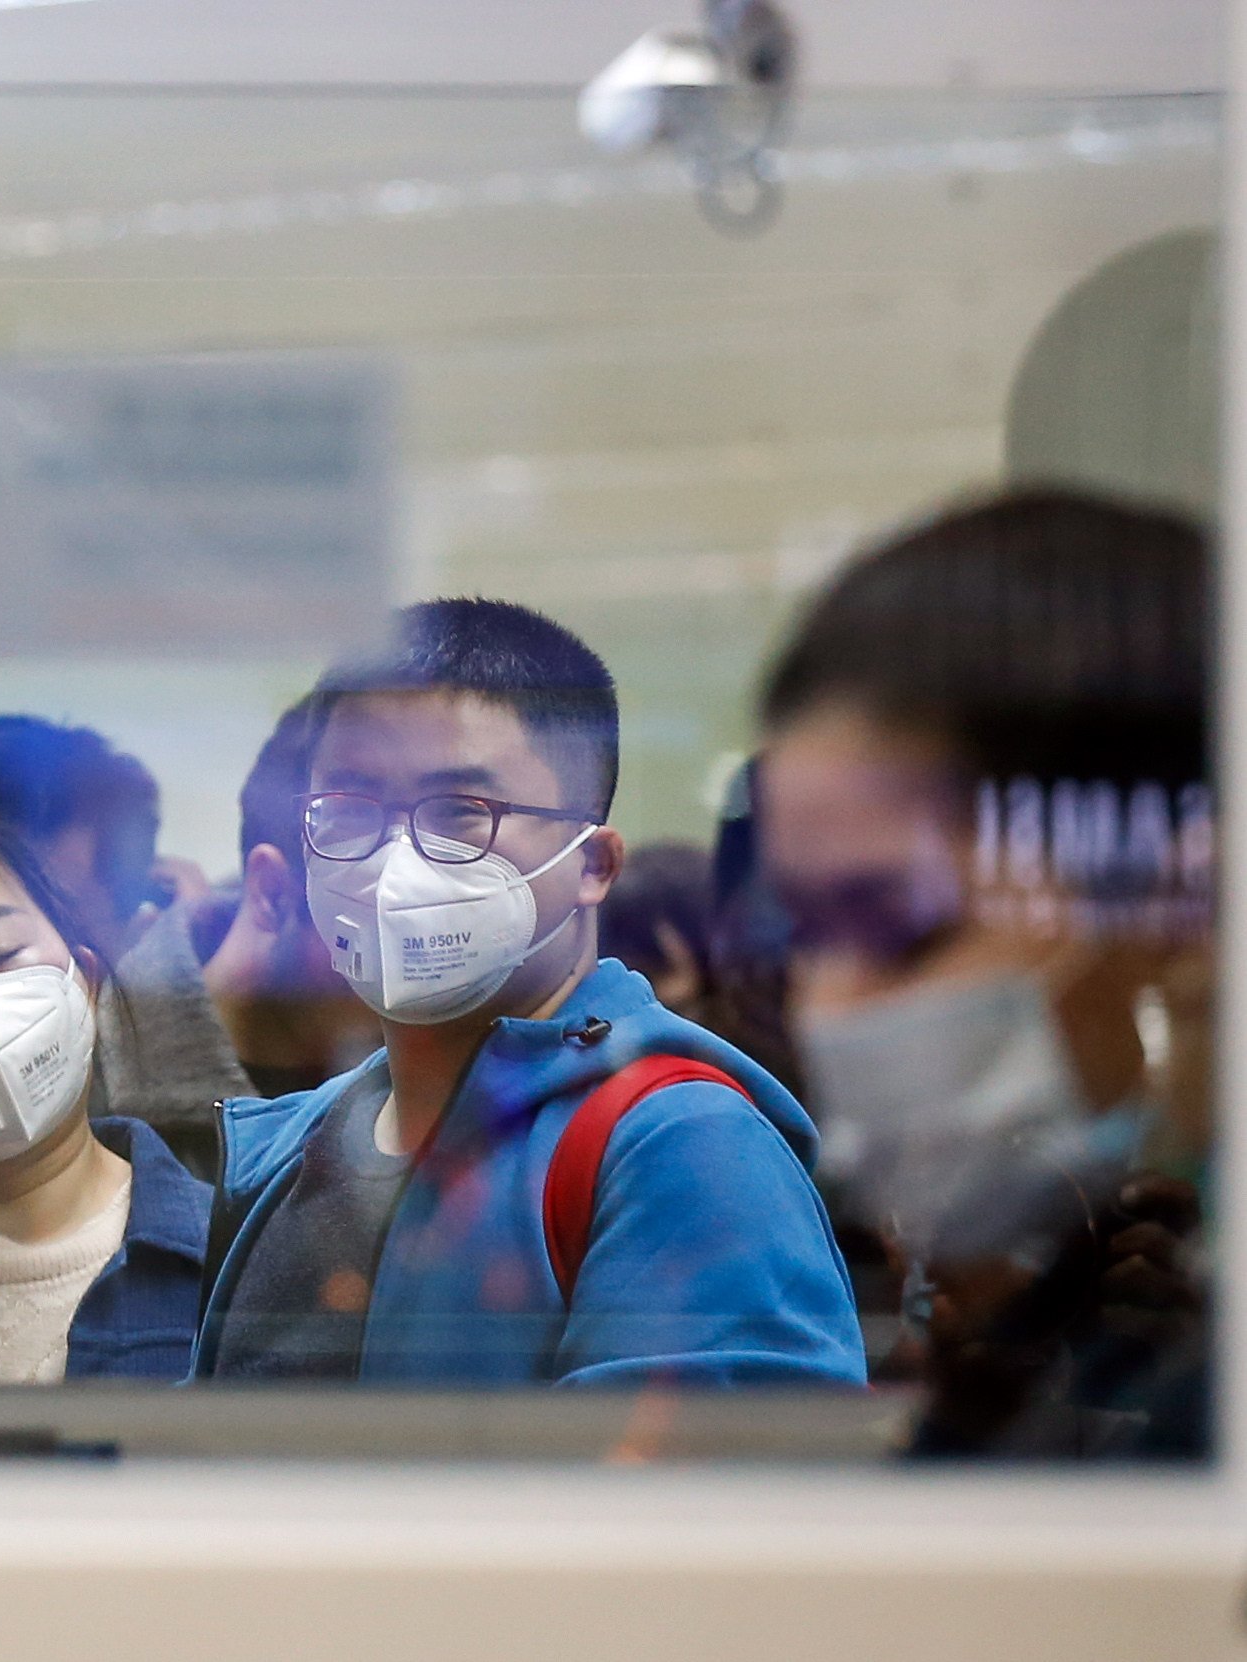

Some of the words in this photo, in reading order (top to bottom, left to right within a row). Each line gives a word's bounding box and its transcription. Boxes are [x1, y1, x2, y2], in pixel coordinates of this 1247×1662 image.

[403, 936, 425, 950] 3M
[429, 931, 472, 949] 9501V
[19, 1062, 34, 1079] 3M
